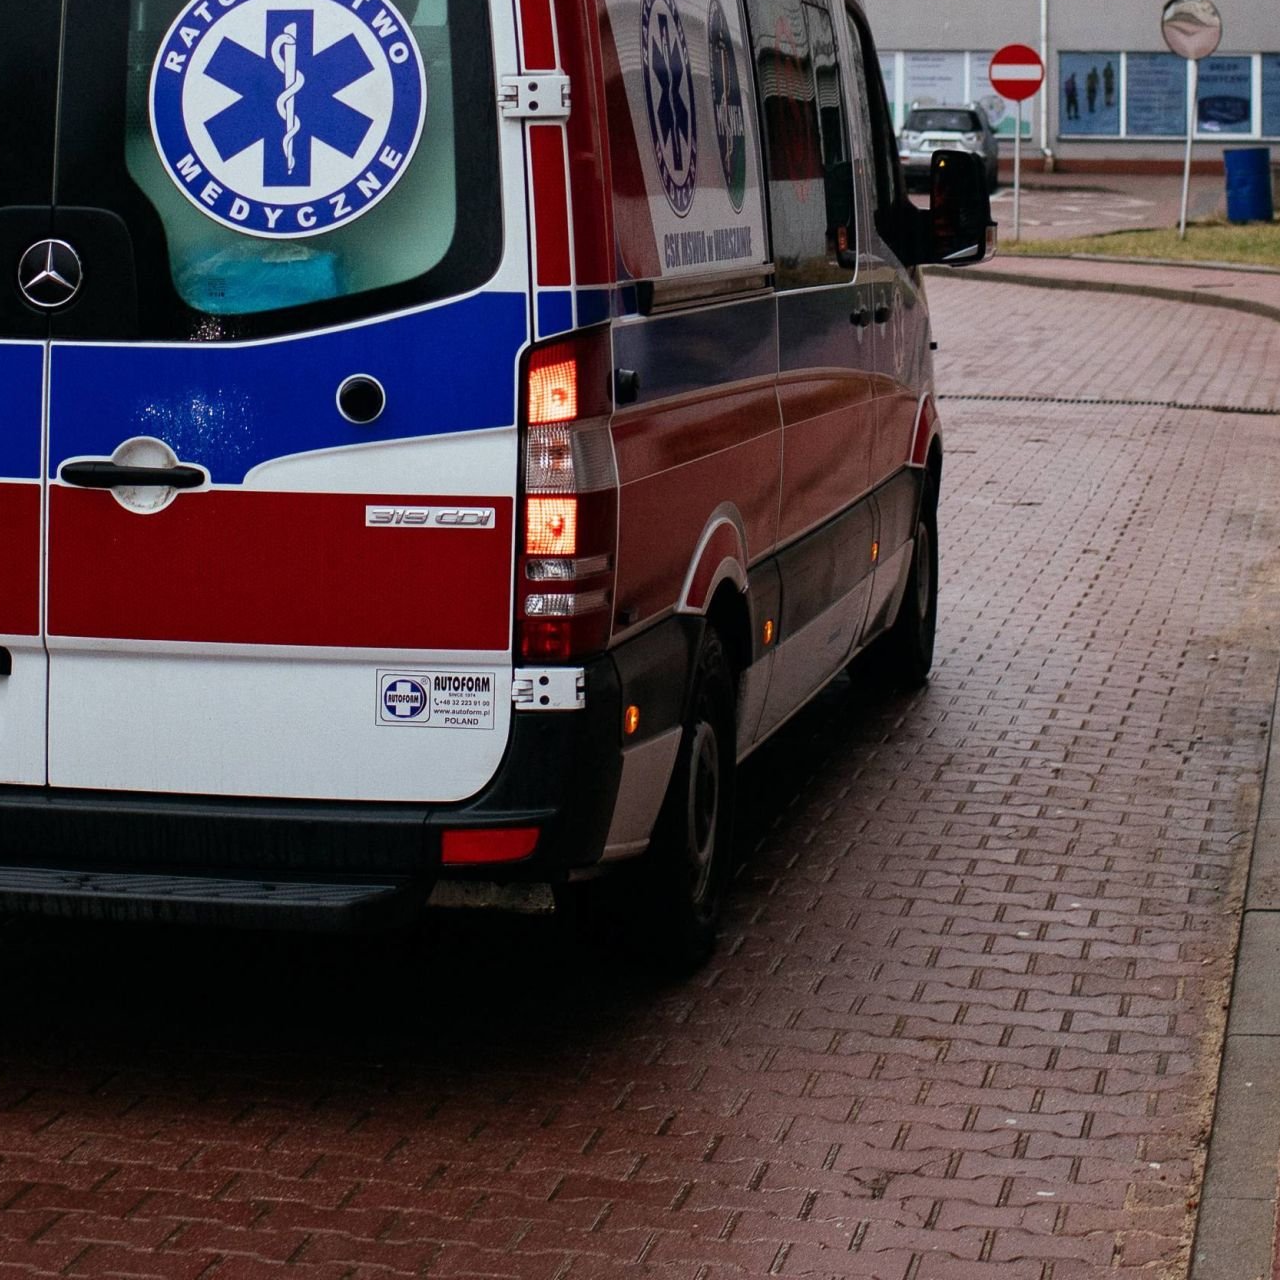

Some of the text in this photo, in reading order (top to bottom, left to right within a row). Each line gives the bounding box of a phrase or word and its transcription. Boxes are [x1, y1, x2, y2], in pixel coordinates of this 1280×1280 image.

[175, 143, 404, 229] MEDYCZNE
[435, 508, 492, 527] CDI
[433, 675, 491, 692] AUTOFORM
[388, 694, 419, 703] AUTOFORM
[433, 708, 491, 717] www.autoform.pl
[444, 717, 479, 726] POLAND
